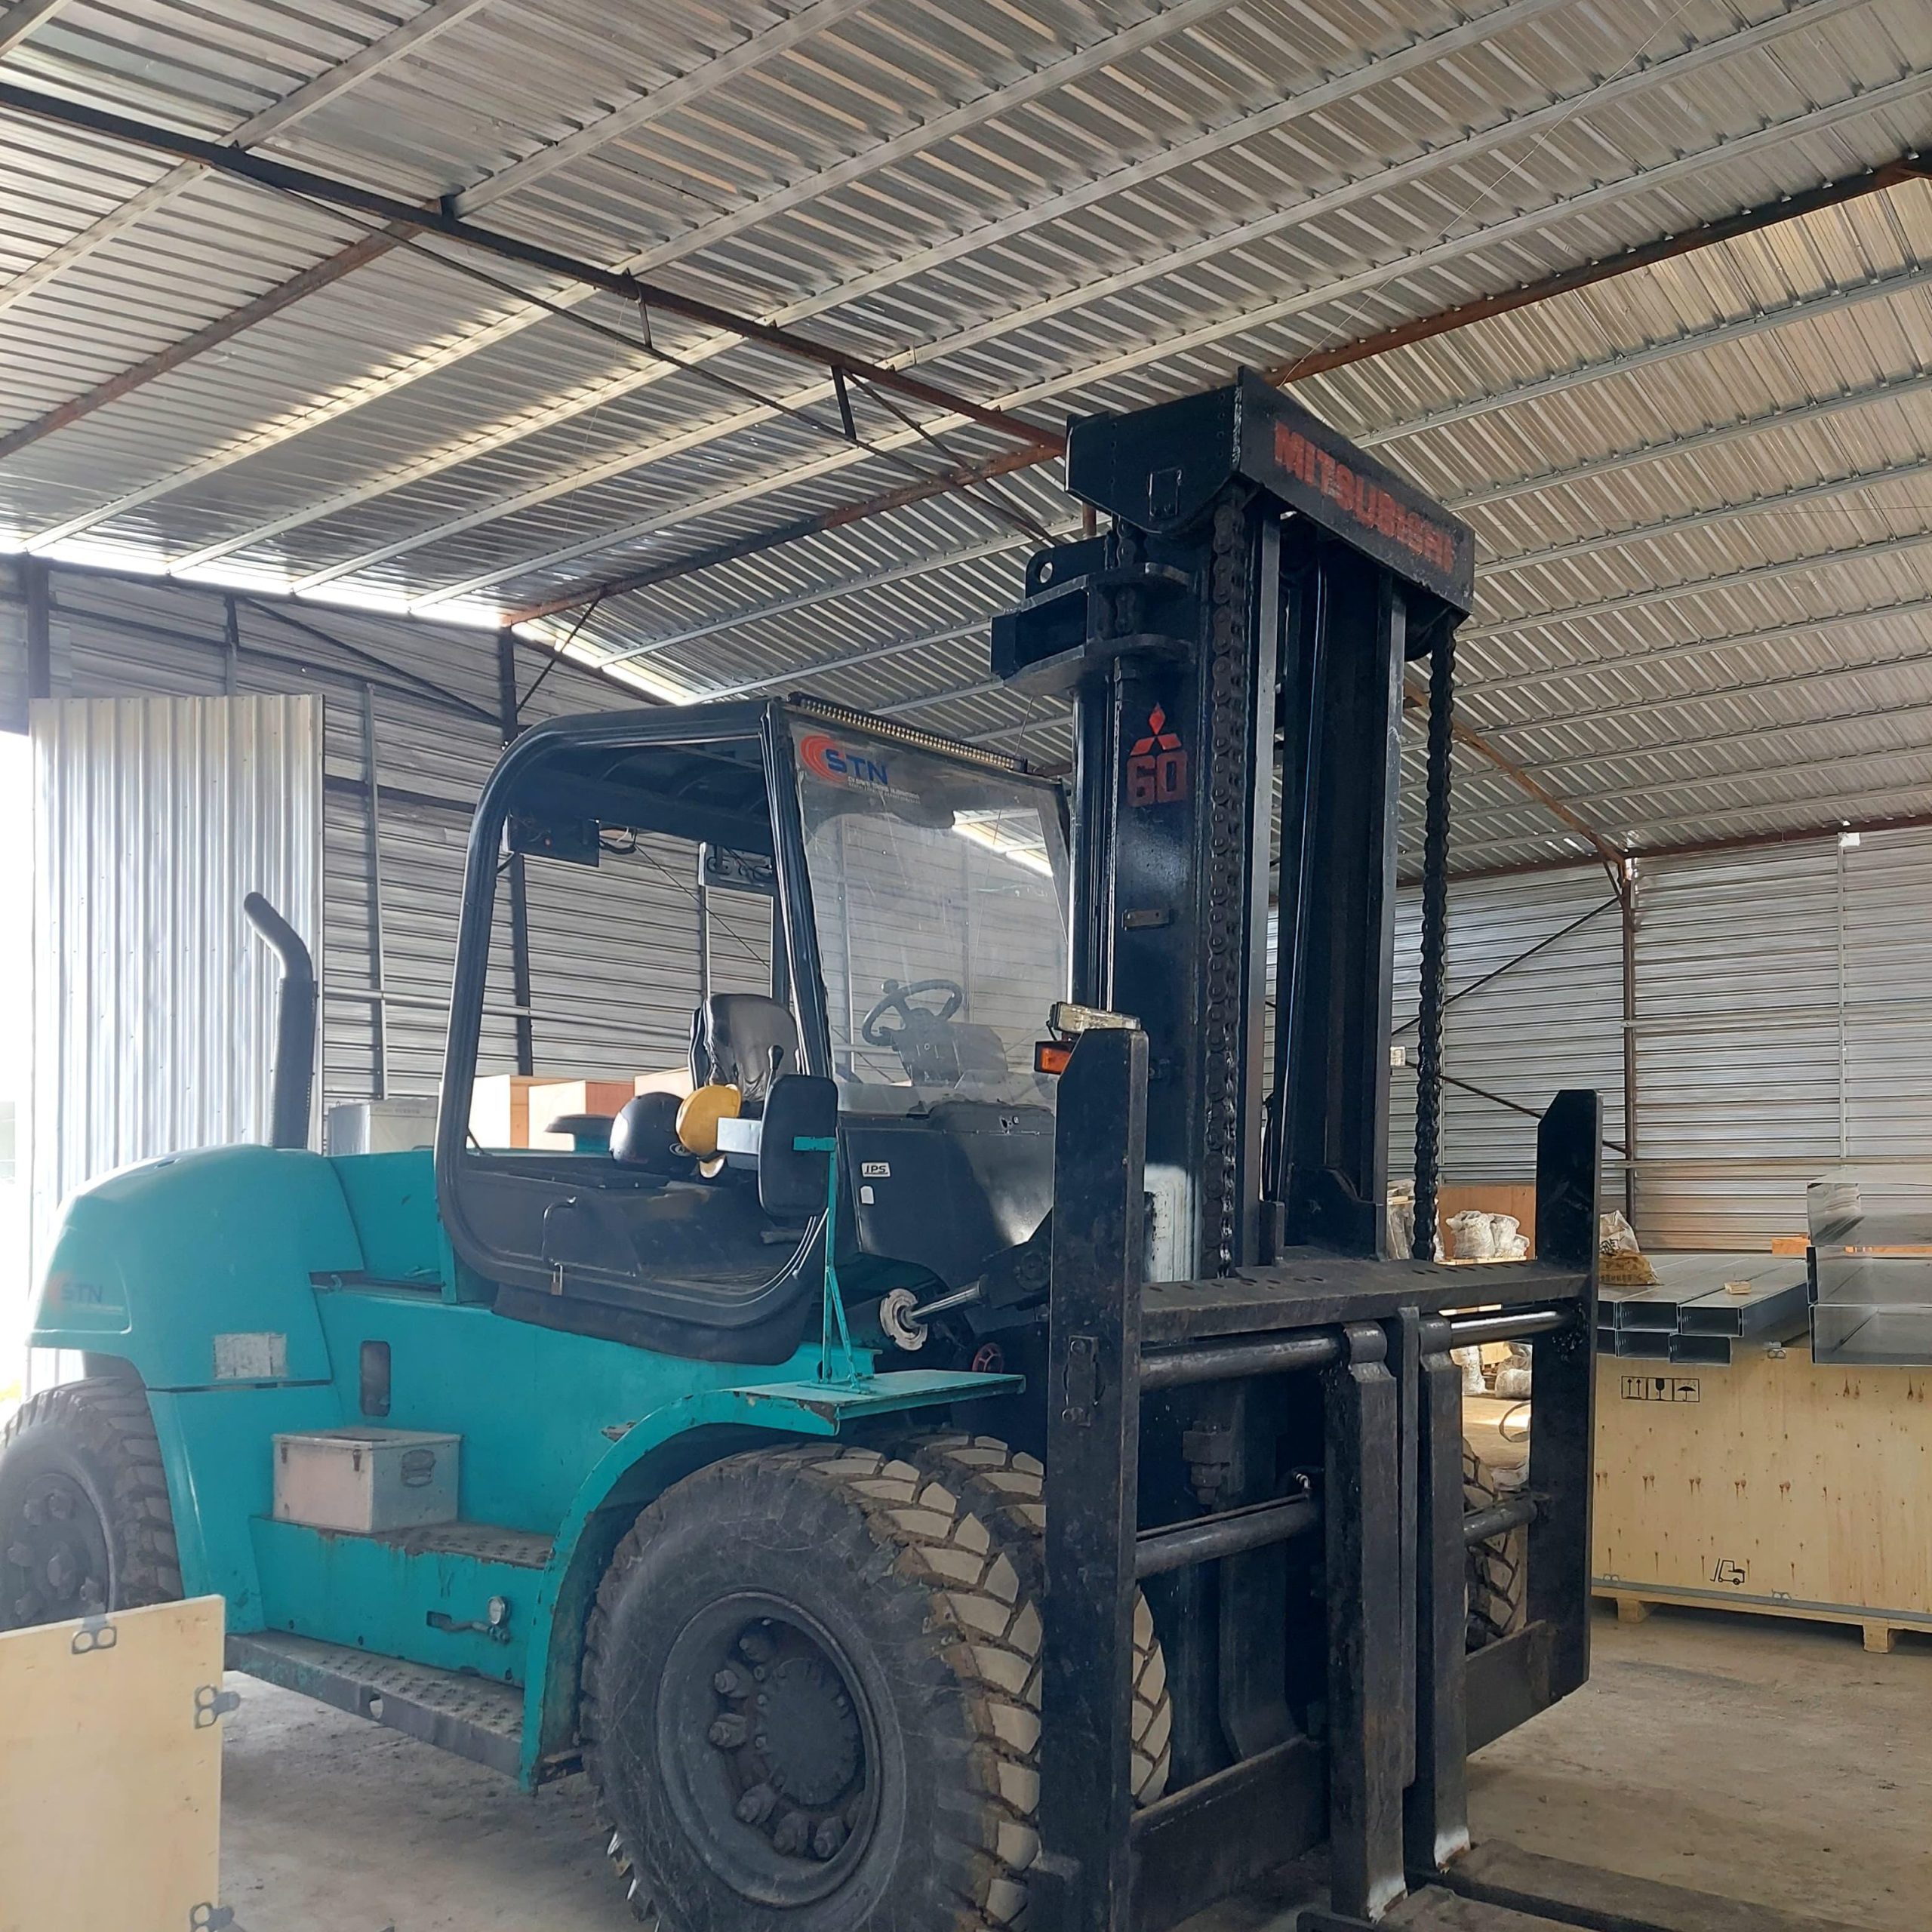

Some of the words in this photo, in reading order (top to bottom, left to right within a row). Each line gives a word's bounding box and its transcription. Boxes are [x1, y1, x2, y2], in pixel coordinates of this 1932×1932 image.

[826, 748, 888, 785] STN
[1127, 750, 1188, 807] 60
[60, 1283, 103, 1303] STN
